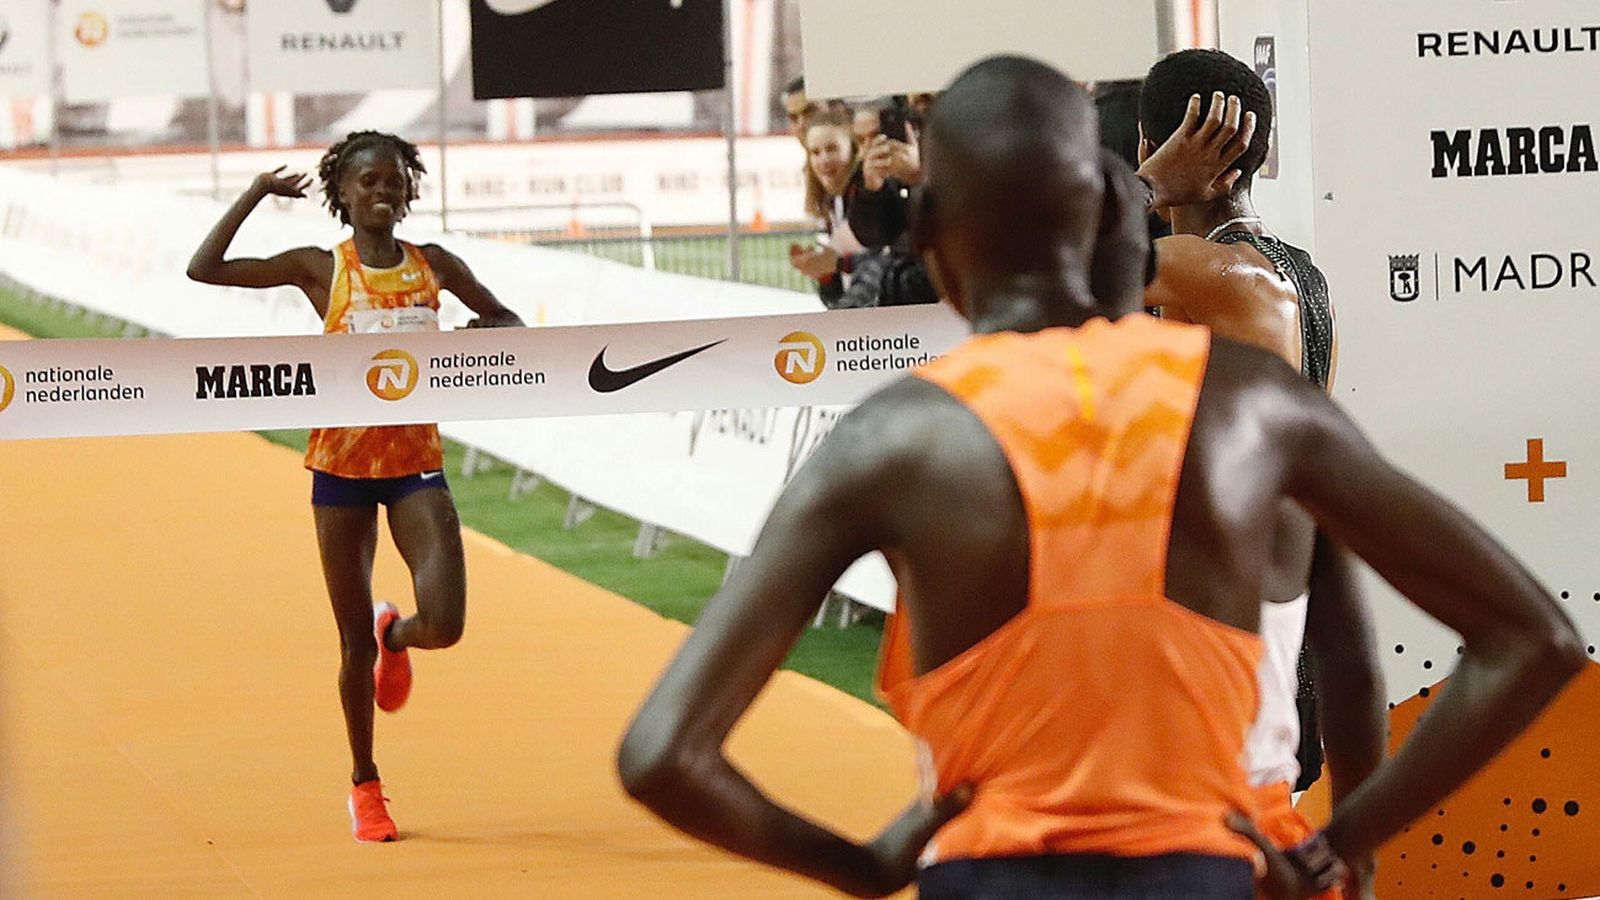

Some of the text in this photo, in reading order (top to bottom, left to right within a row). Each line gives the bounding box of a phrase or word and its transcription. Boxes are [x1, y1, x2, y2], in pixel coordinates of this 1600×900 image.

[280, 31, 404, 52] RENAULT
[1417, 27, 1600, 58] RENAULT
[1430, 125, 1599, 178] MARCA
[836, 333, 920, 352] nationale
[430, 351, 516, 369] nationale
[836, 352, 949, 372] nederlande
[26, 365, 114, 383] nationale
[195, 362, 316, 400] MARCA
[430, 370, 545, 389] nederlanden
[26, 382, 144, 403] nederlanden
